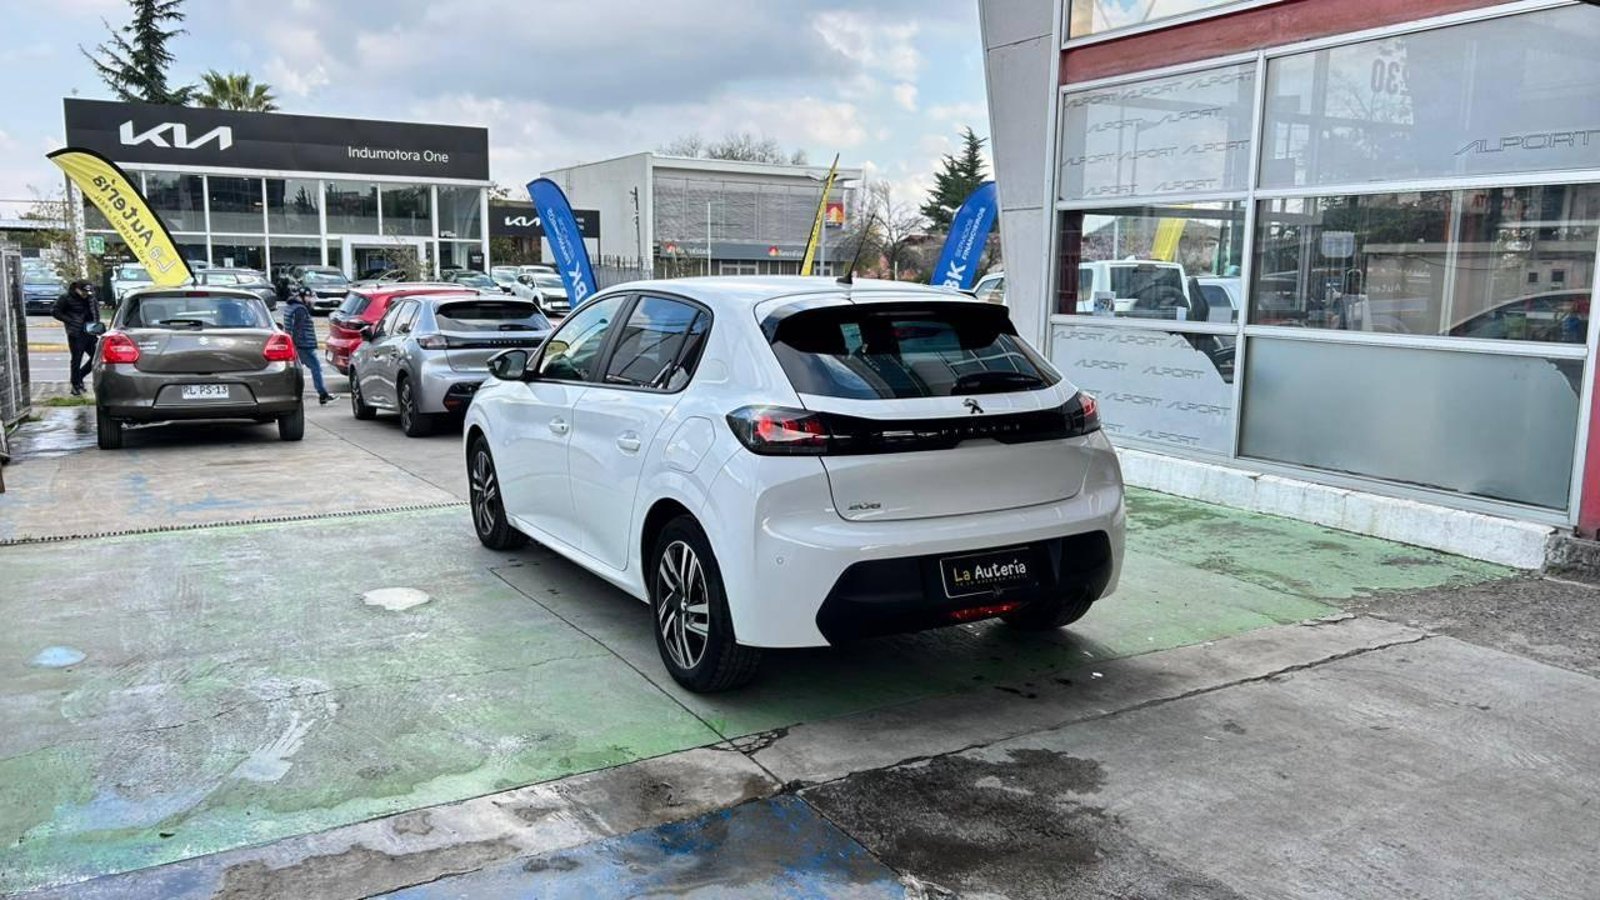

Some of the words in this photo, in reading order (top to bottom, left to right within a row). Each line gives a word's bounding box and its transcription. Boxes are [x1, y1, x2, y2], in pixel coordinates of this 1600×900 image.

[1121, 83, 1181, 99] ALPORT
[1088, 118, 1143, 134] ALPORT
[1155, 108, 1223, 125] ALPORT
[119, 120, 233, 151] KIA
[1454, 130, 1600, 156] ALPORT
[347, 146, 421, 162] Indumotora
[423, 150, 449, 164] One
[1142, 366, 1204, 379] ALPORT
[1167, 401, 1231, 415] ALPORT
[953, 567, 971, 583] La
[975, 558, 1027, 580] Autería
